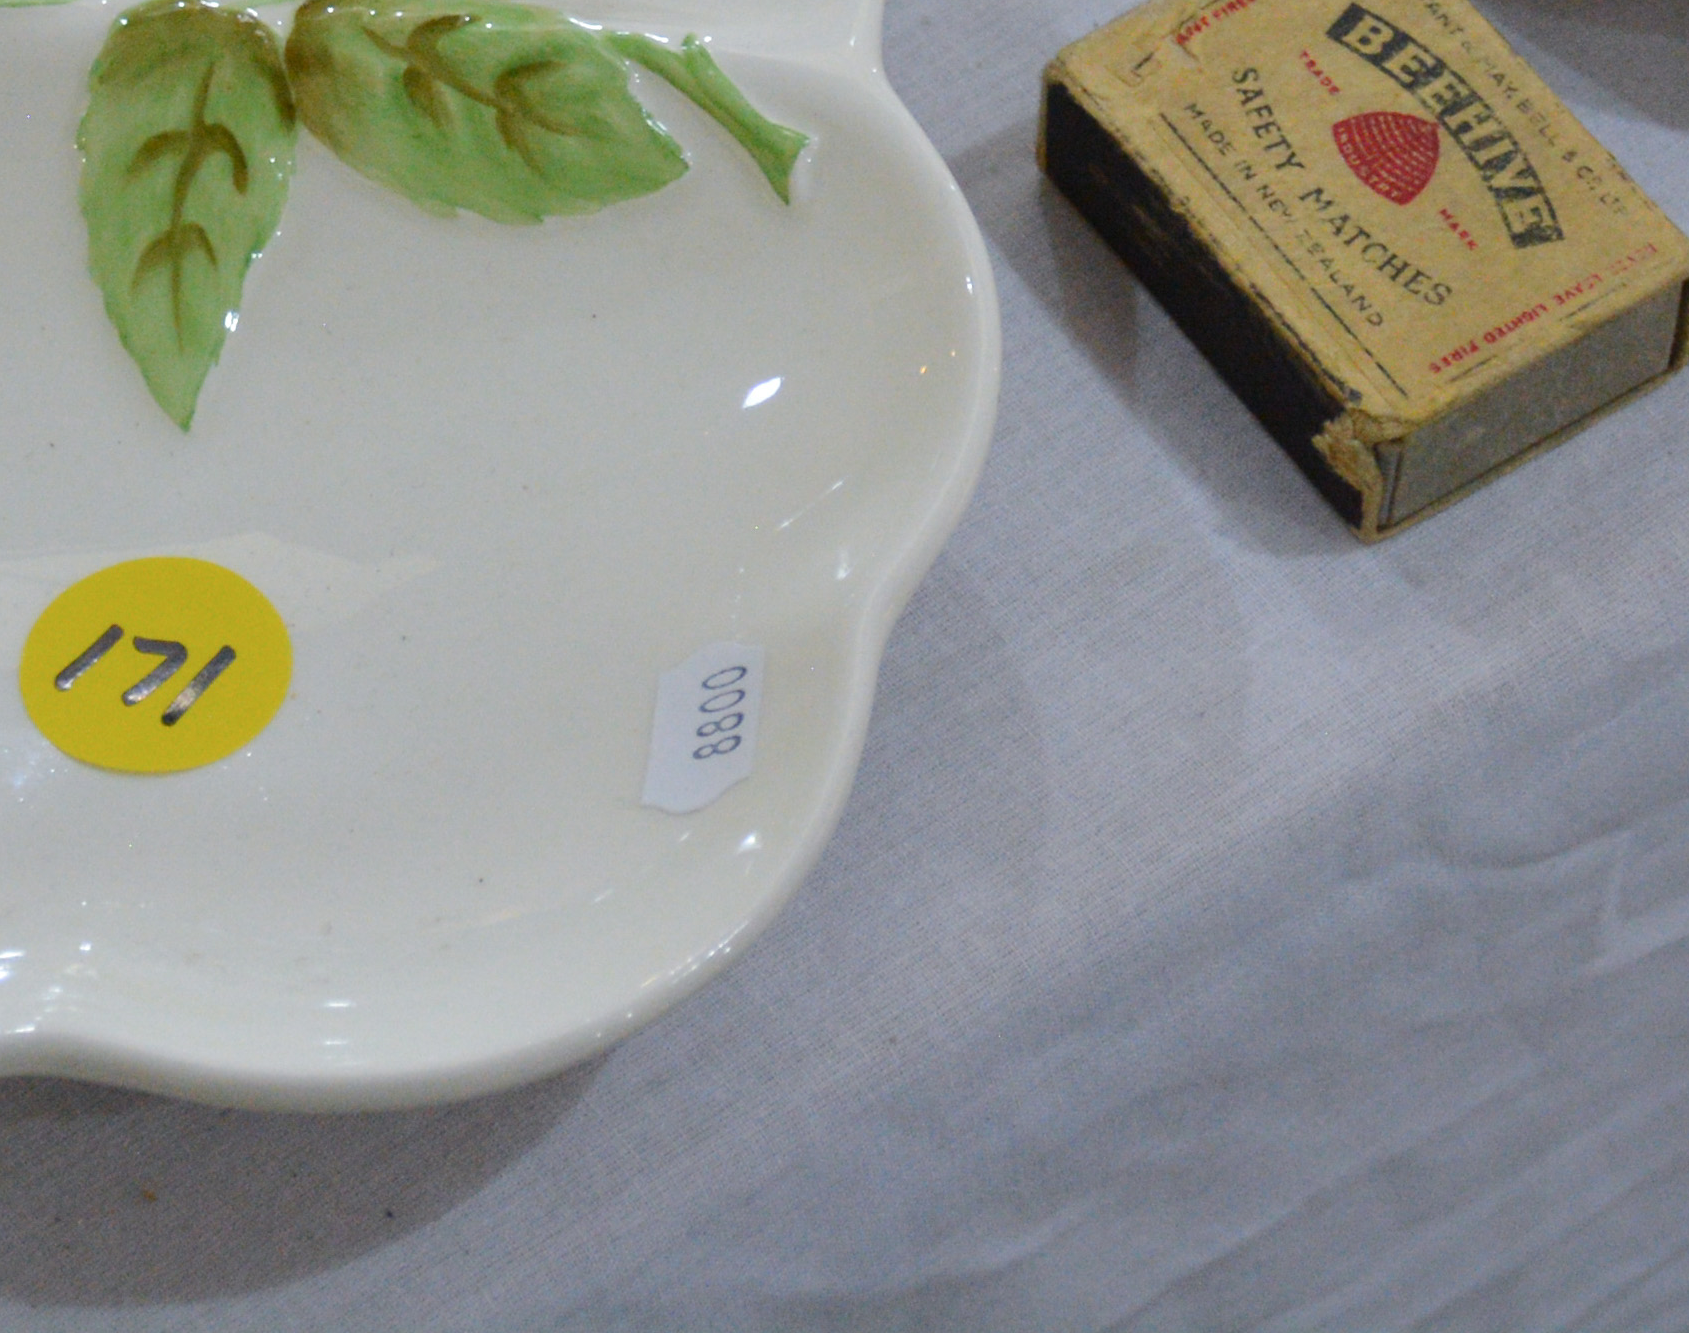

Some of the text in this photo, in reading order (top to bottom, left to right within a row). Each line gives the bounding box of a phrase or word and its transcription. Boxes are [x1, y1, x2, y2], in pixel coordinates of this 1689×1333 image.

[1299, 49, 1341, 96] TRADE
[1337, 10, 1558, 239] BEEHIVE
[1183, 101, 1237, 157] MADE
[1234, 158, 1258, 182] IN
[1295, 228, 1385, 328] ZEALAND
[1231, 66, 1454, 308] SAFETY MATCHES
[1438, 207, 1479, 251] MARK
[53, 623, 237, 727] 171
